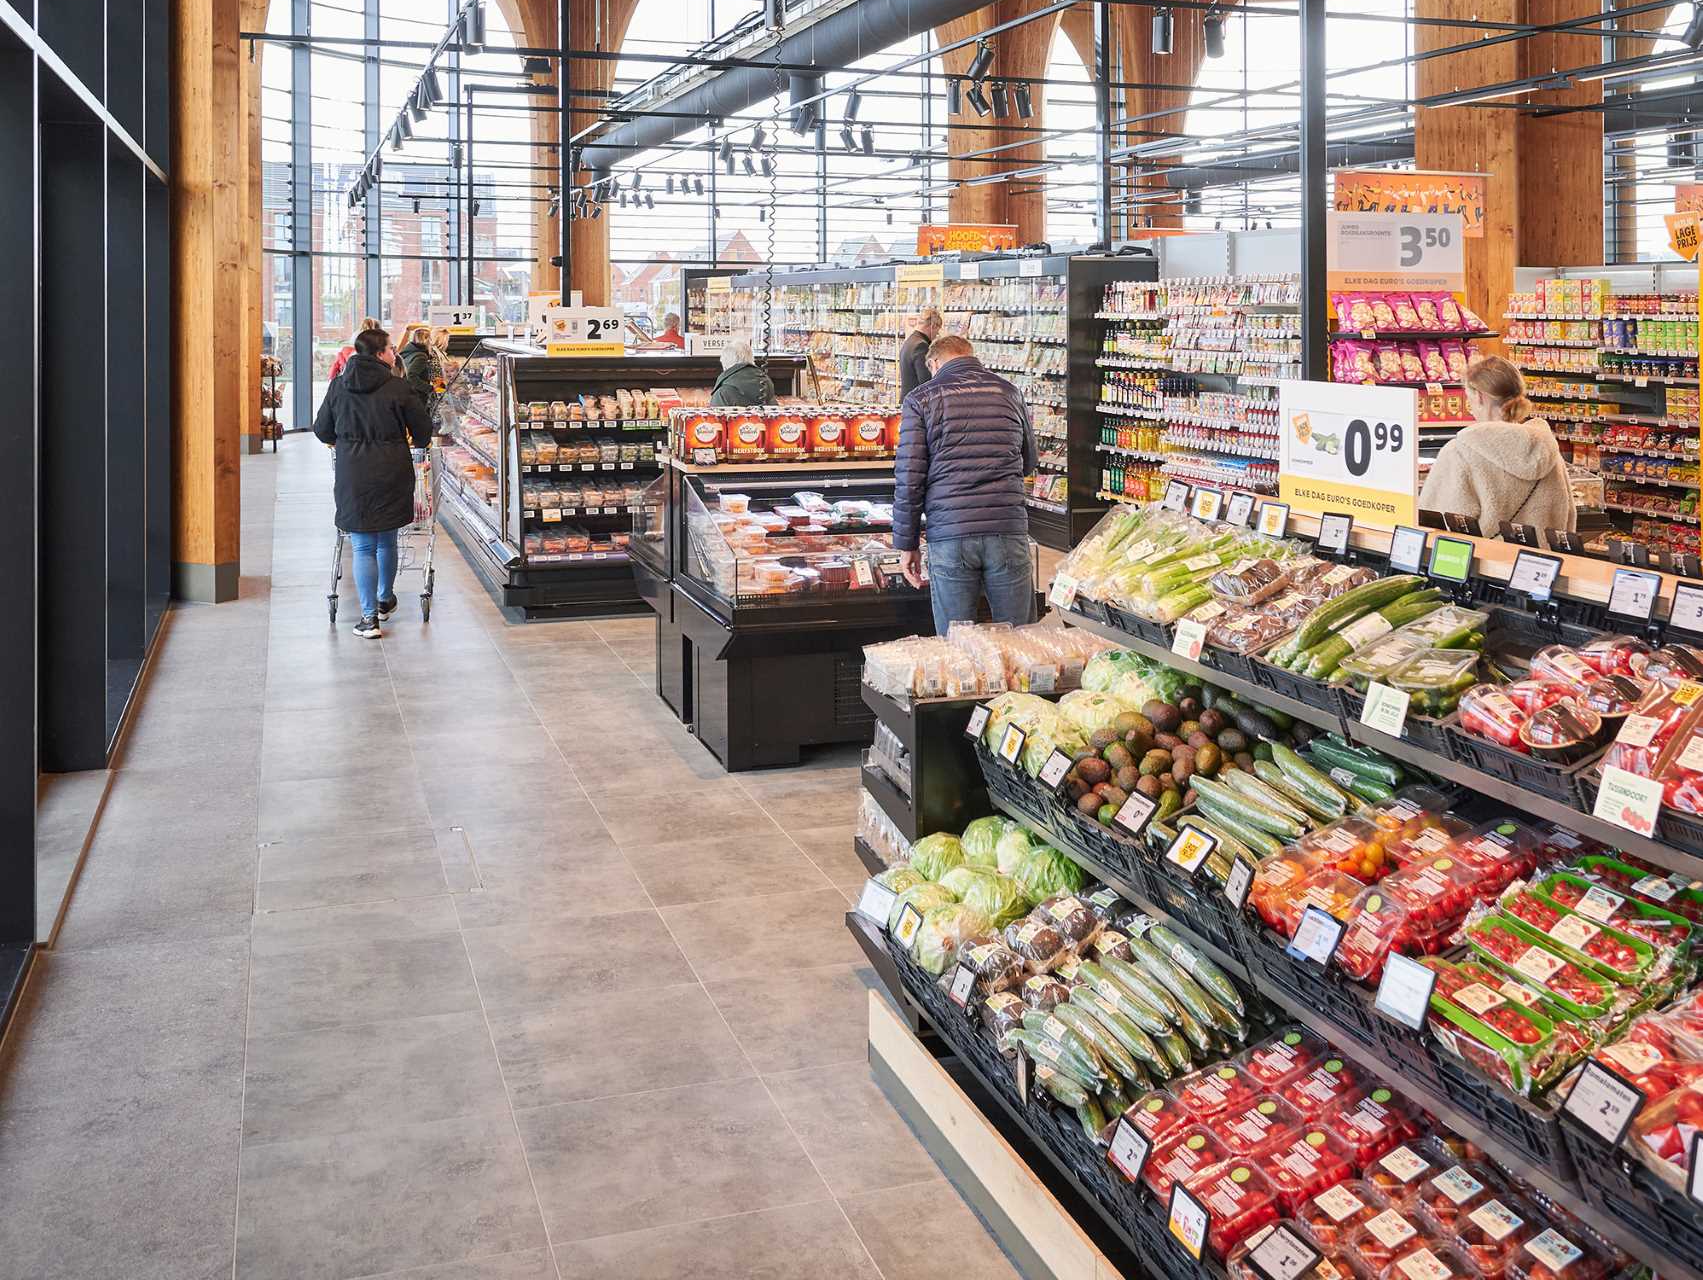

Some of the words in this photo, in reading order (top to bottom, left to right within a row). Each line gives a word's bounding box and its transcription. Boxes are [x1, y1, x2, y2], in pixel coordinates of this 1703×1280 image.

[1674, 225, 1696, 239] LAGE
[1676, 235, 1698, 250] PRIJS
[1344, 277, 1361, 285] ELKE
[1363, 277, 1379, 285] DAG
[1294, 488, 1310, 498] ELKE
[1311, 490, 1326, 501] DAG
[1326, 493, 1351, 506] EURO'S
[1352, 498, 1396, 514] GOEDKOPER
